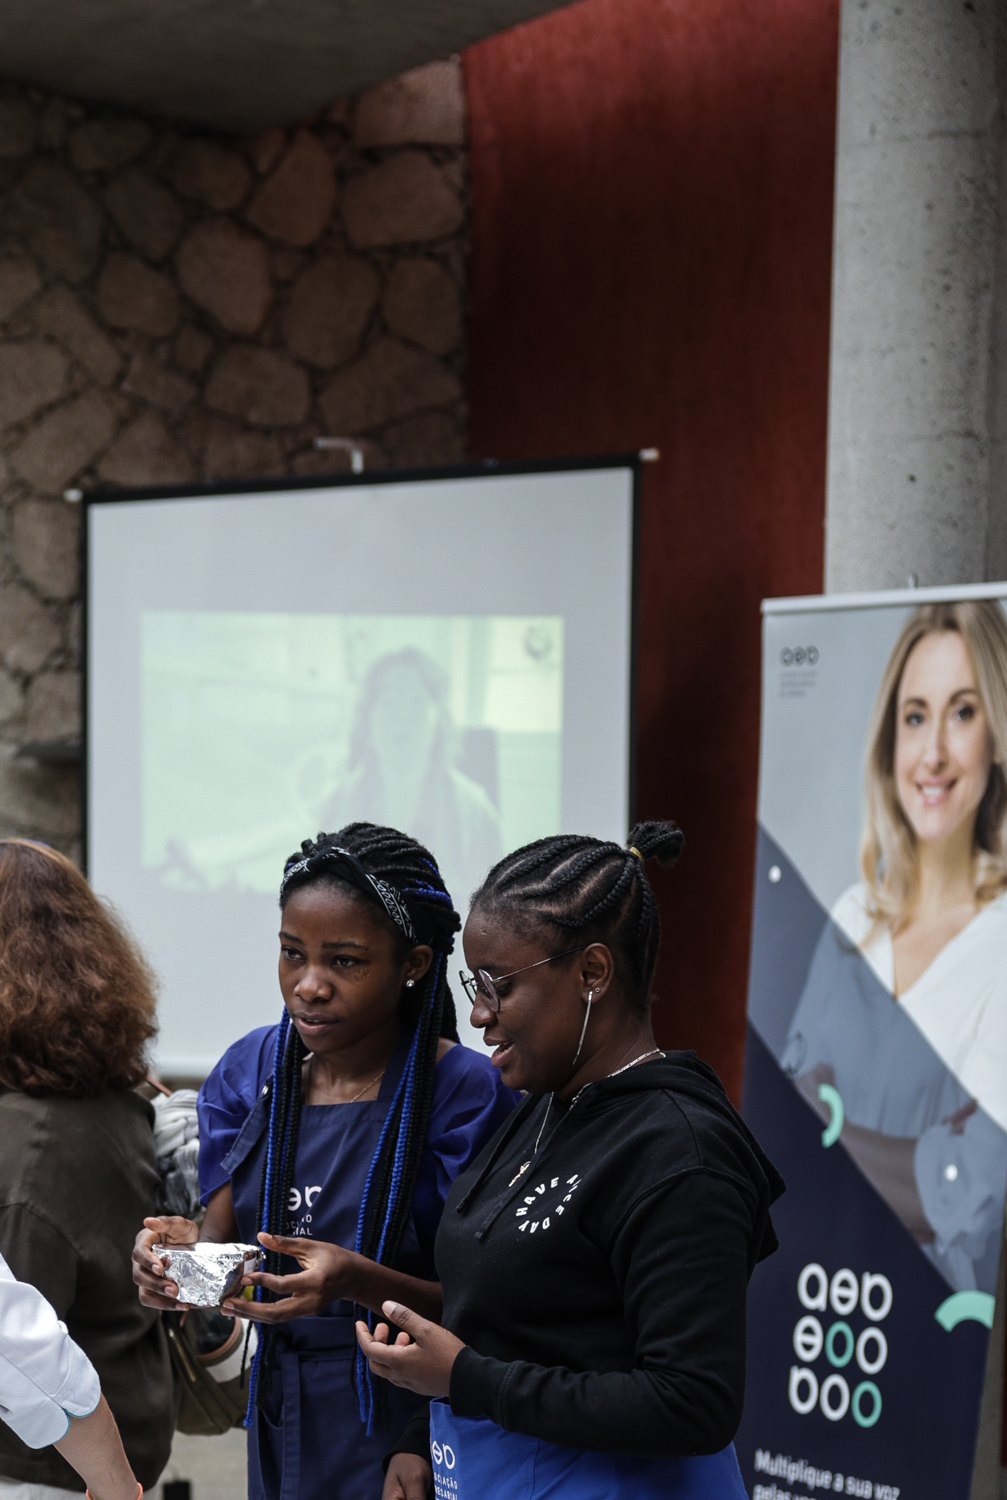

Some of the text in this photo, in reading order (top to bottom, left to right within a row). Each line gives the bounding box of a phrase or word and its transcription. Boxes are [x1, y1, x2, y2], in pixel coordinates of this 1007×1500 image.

[515, 1176, 560, 1217] HAVE
[518, 1217, 551, 1234] DAY
[434, 1472, 458, 1490] OCIAÇÃO
[754, 1448, 832, 1491] Multiplique
[832, 1473, 844, 1492] a
[844, 1476, 873, 1499] sua
